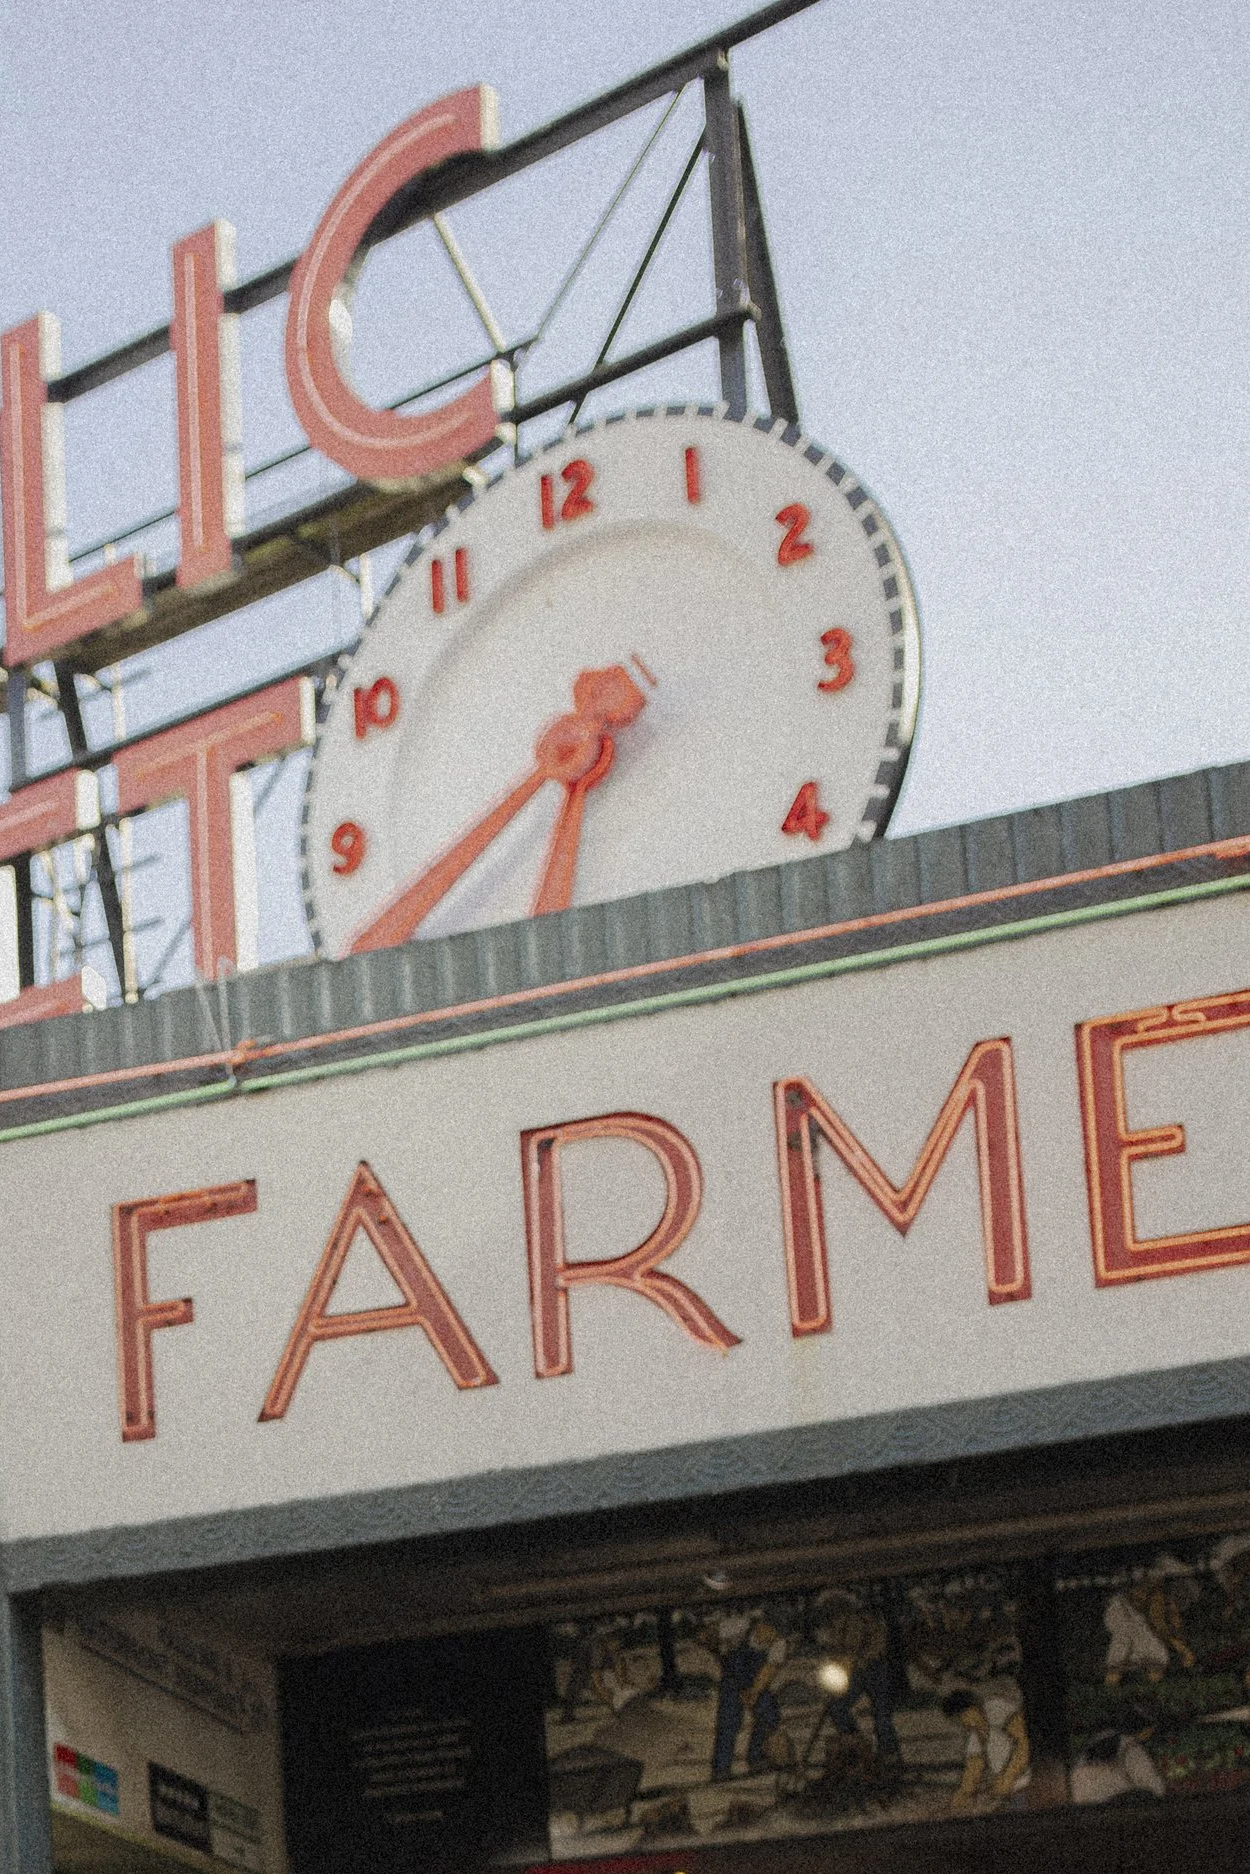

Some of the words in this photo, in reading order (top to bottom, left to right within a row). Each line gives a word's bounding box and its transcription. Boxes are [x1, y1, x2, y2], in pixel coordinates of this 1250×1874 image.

[540, 458, 594, 529] 12
[684, 446, 701, 504] 1
[775, 503, 813, 567] 2
[430, 548, 469, 613] 11
[817, 627, 854, 693] 3
[352, 676, 400, 738] 10
[780, 780, 830, 842] 4
[330, 820, 366, 876] 9
